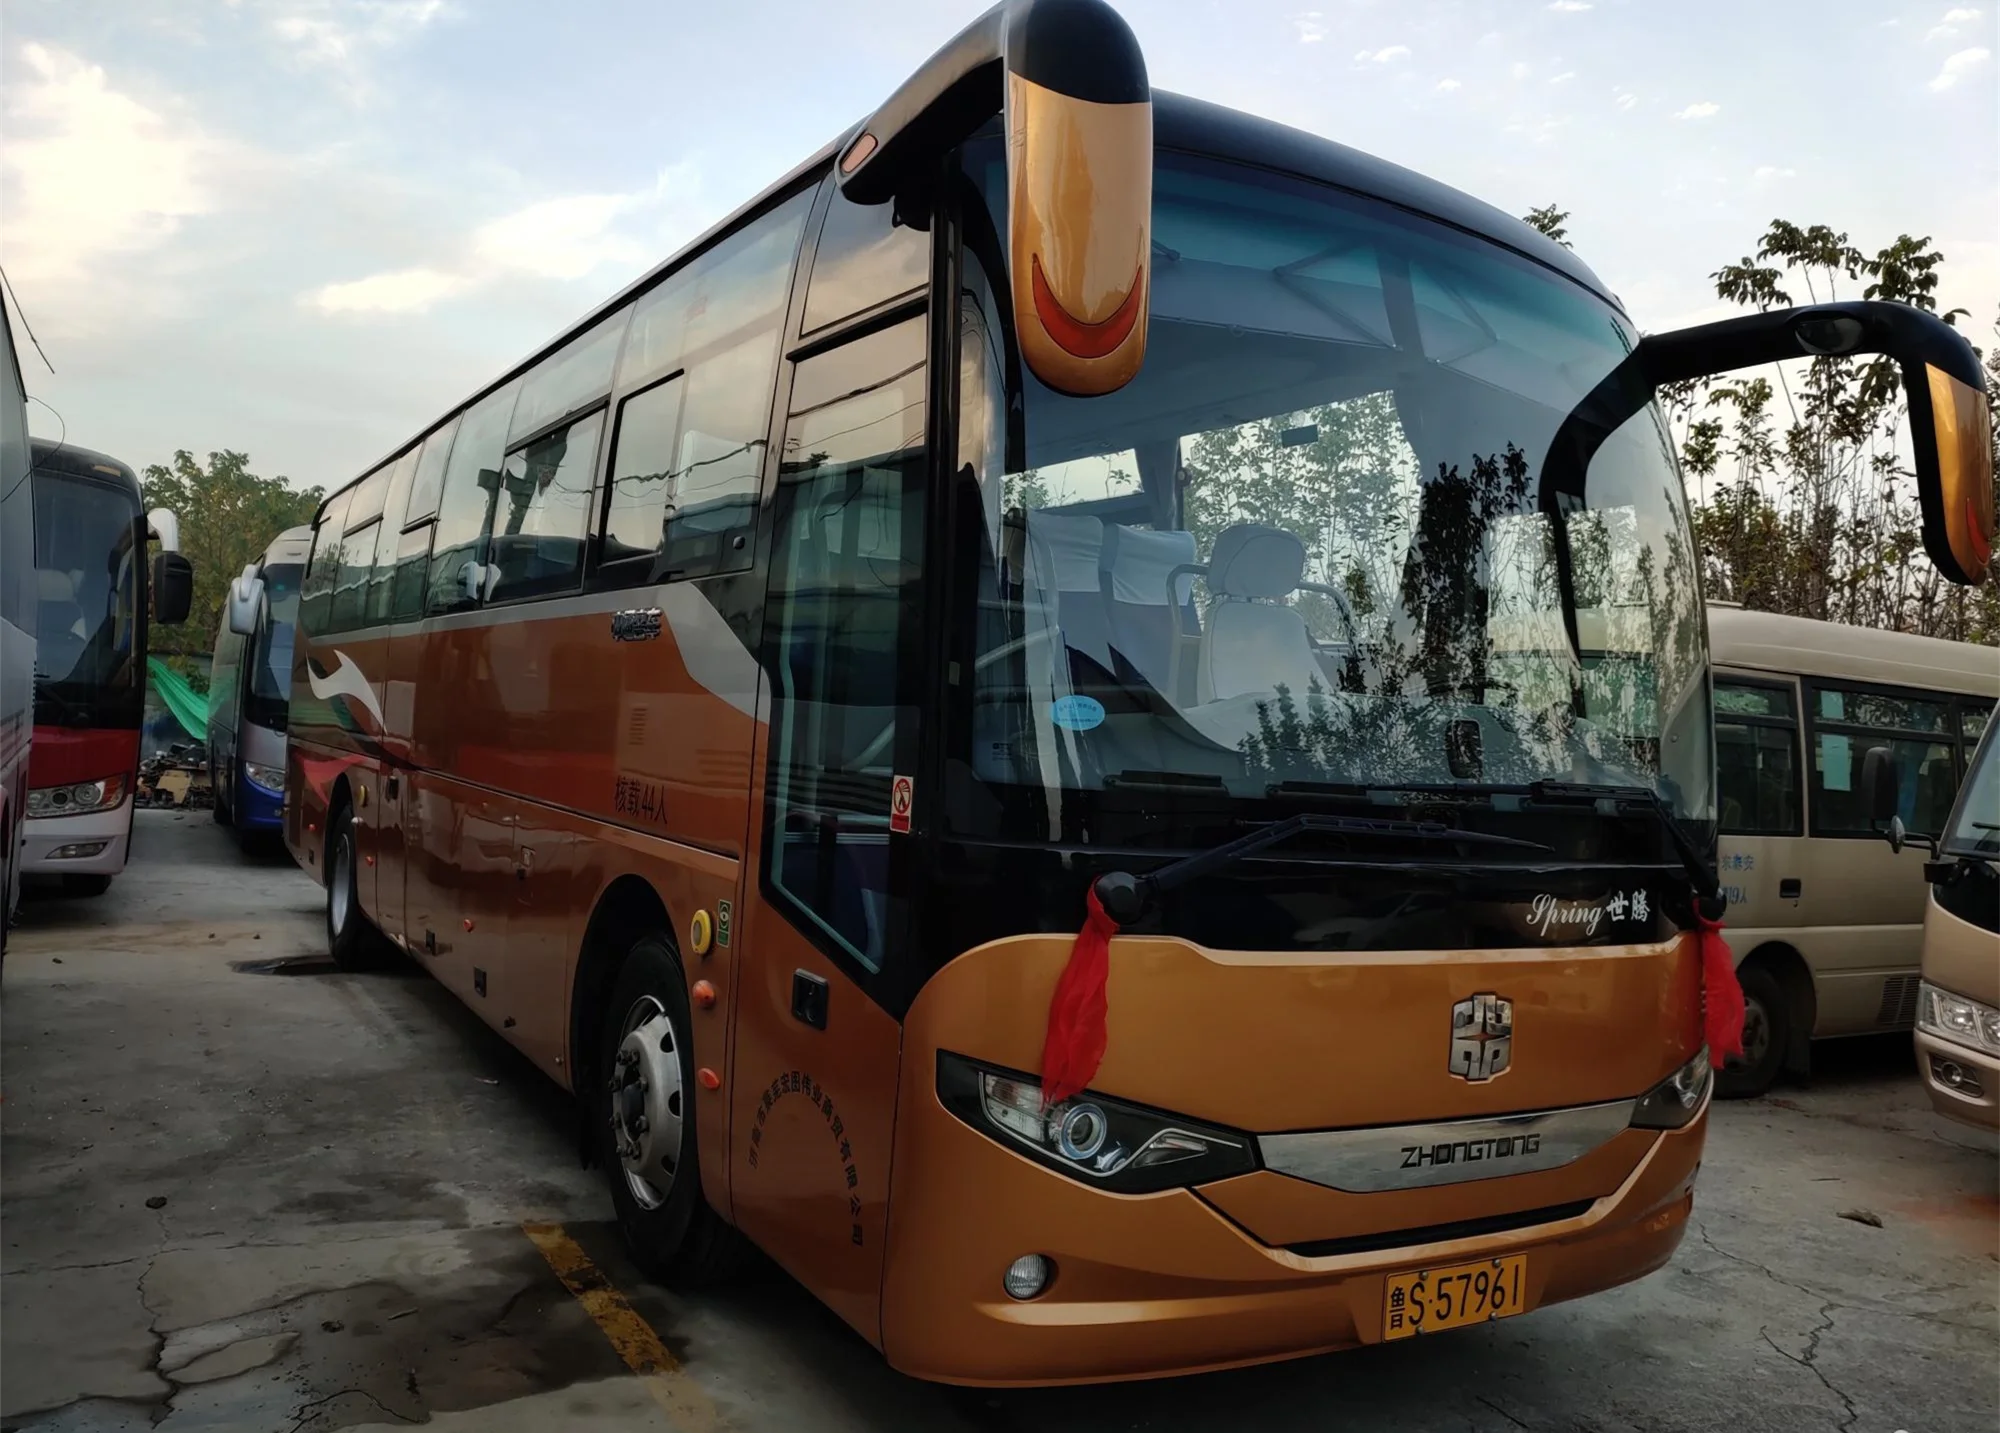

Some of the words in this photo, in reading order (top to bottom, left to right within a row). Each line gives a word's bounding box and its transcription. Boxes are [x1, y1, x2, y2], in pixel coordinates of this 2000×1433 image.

[614, 775, 668, 825] 核载44人
[1525, 892, 1606, 938] Spring
[1400, 1133, 1541, 1169] ZHONGTONG
